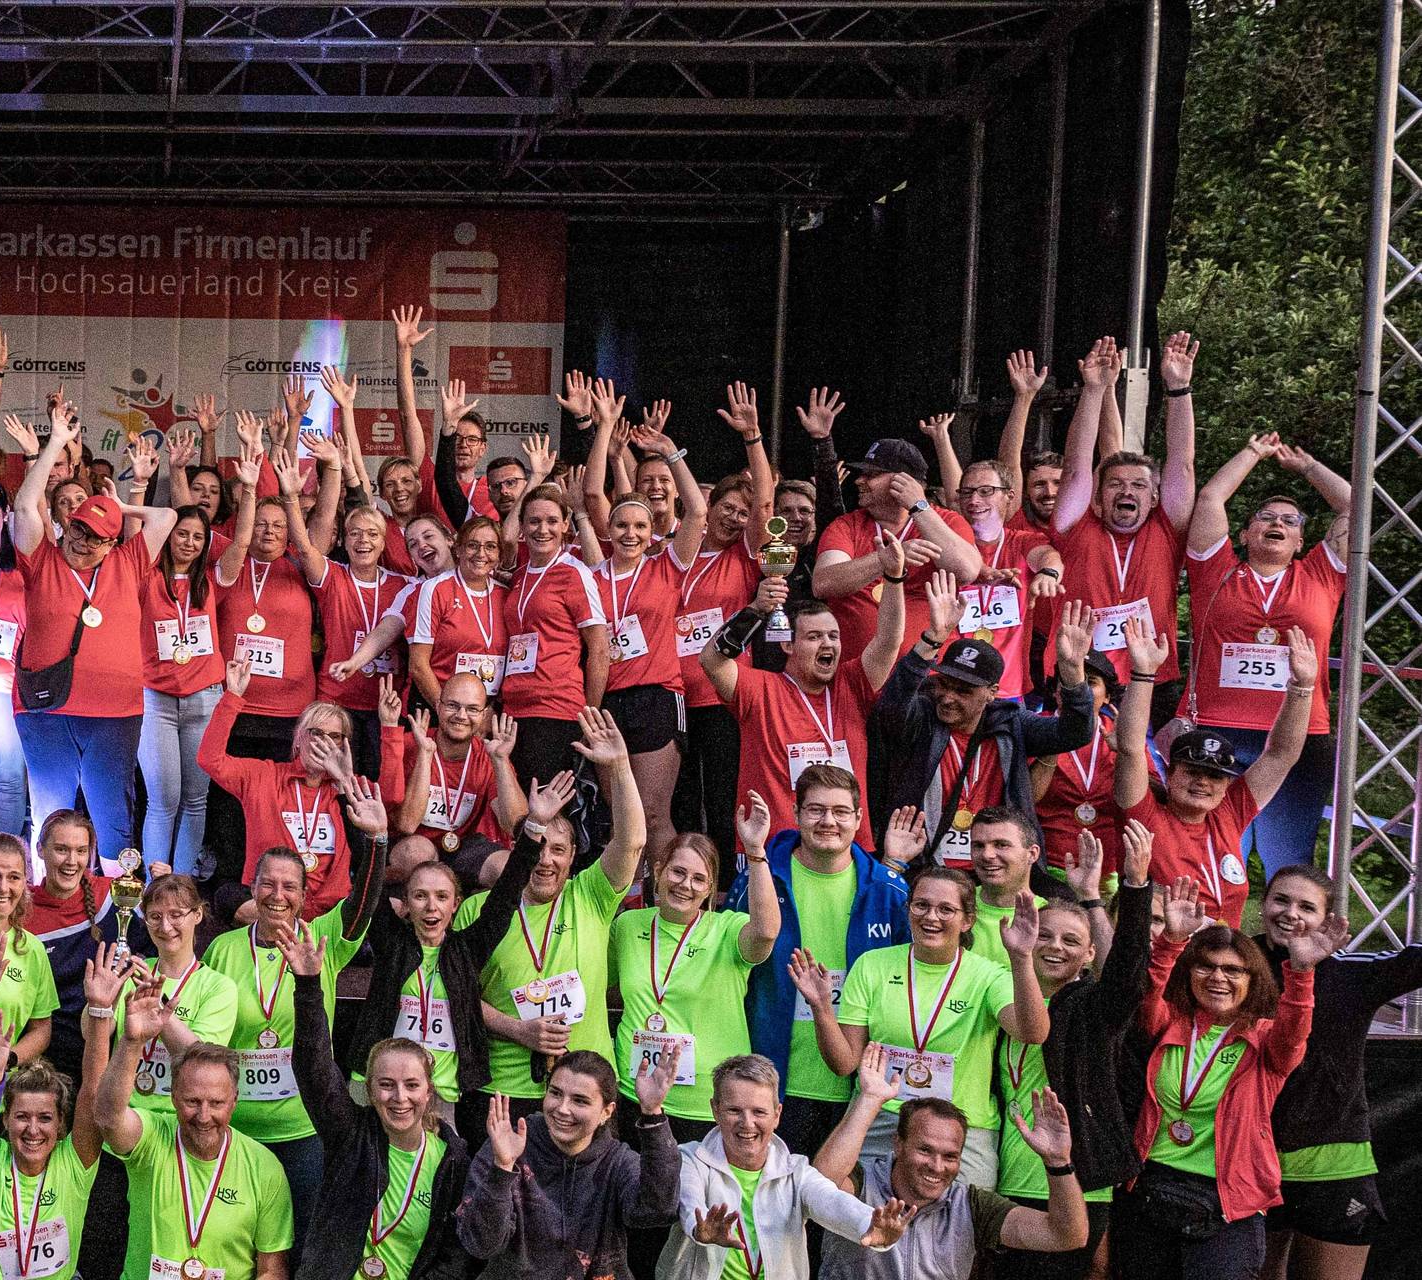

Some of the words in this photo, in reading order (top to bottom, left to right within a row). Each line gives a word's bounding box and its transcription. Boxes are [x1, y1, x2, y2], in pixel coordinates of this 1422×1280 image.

[175, 226, 373, 261] Firmenlauf
[16, 265, 263, 297] Hochsauerland
[279, 270, 359, 299] Kreis
[12, 358, 86, 372] GÖTTGENS
[245, 358, 322, 372] GÖTTGENS
[485, 420, 549, 434] ÖTTGENS
[101, 429, 123, 450] fit
[365, 443, 402, 451] Sparkasse
[1101, 605, 1137, 616] Sparkassen
[248, 649, 273, 664] 215
[1238, 660, 1276, 676] 255
[298, 827, 328, 841] 25
[867, 923, 892, 938] KW
[7, 966, 23, 979] HSK
[405, 999, 443, 1009] Sparsen
[640, 1034, 676, 1043] Sparkassen
[241, 1053, 278, 1061] Sparkassen
[245, 1069, 281, 1085] 809
[218, 1186, 238, 1200] HSK
[418, 1190, 432, 1204] HS
[25, 1242, 55, 1262] 76
